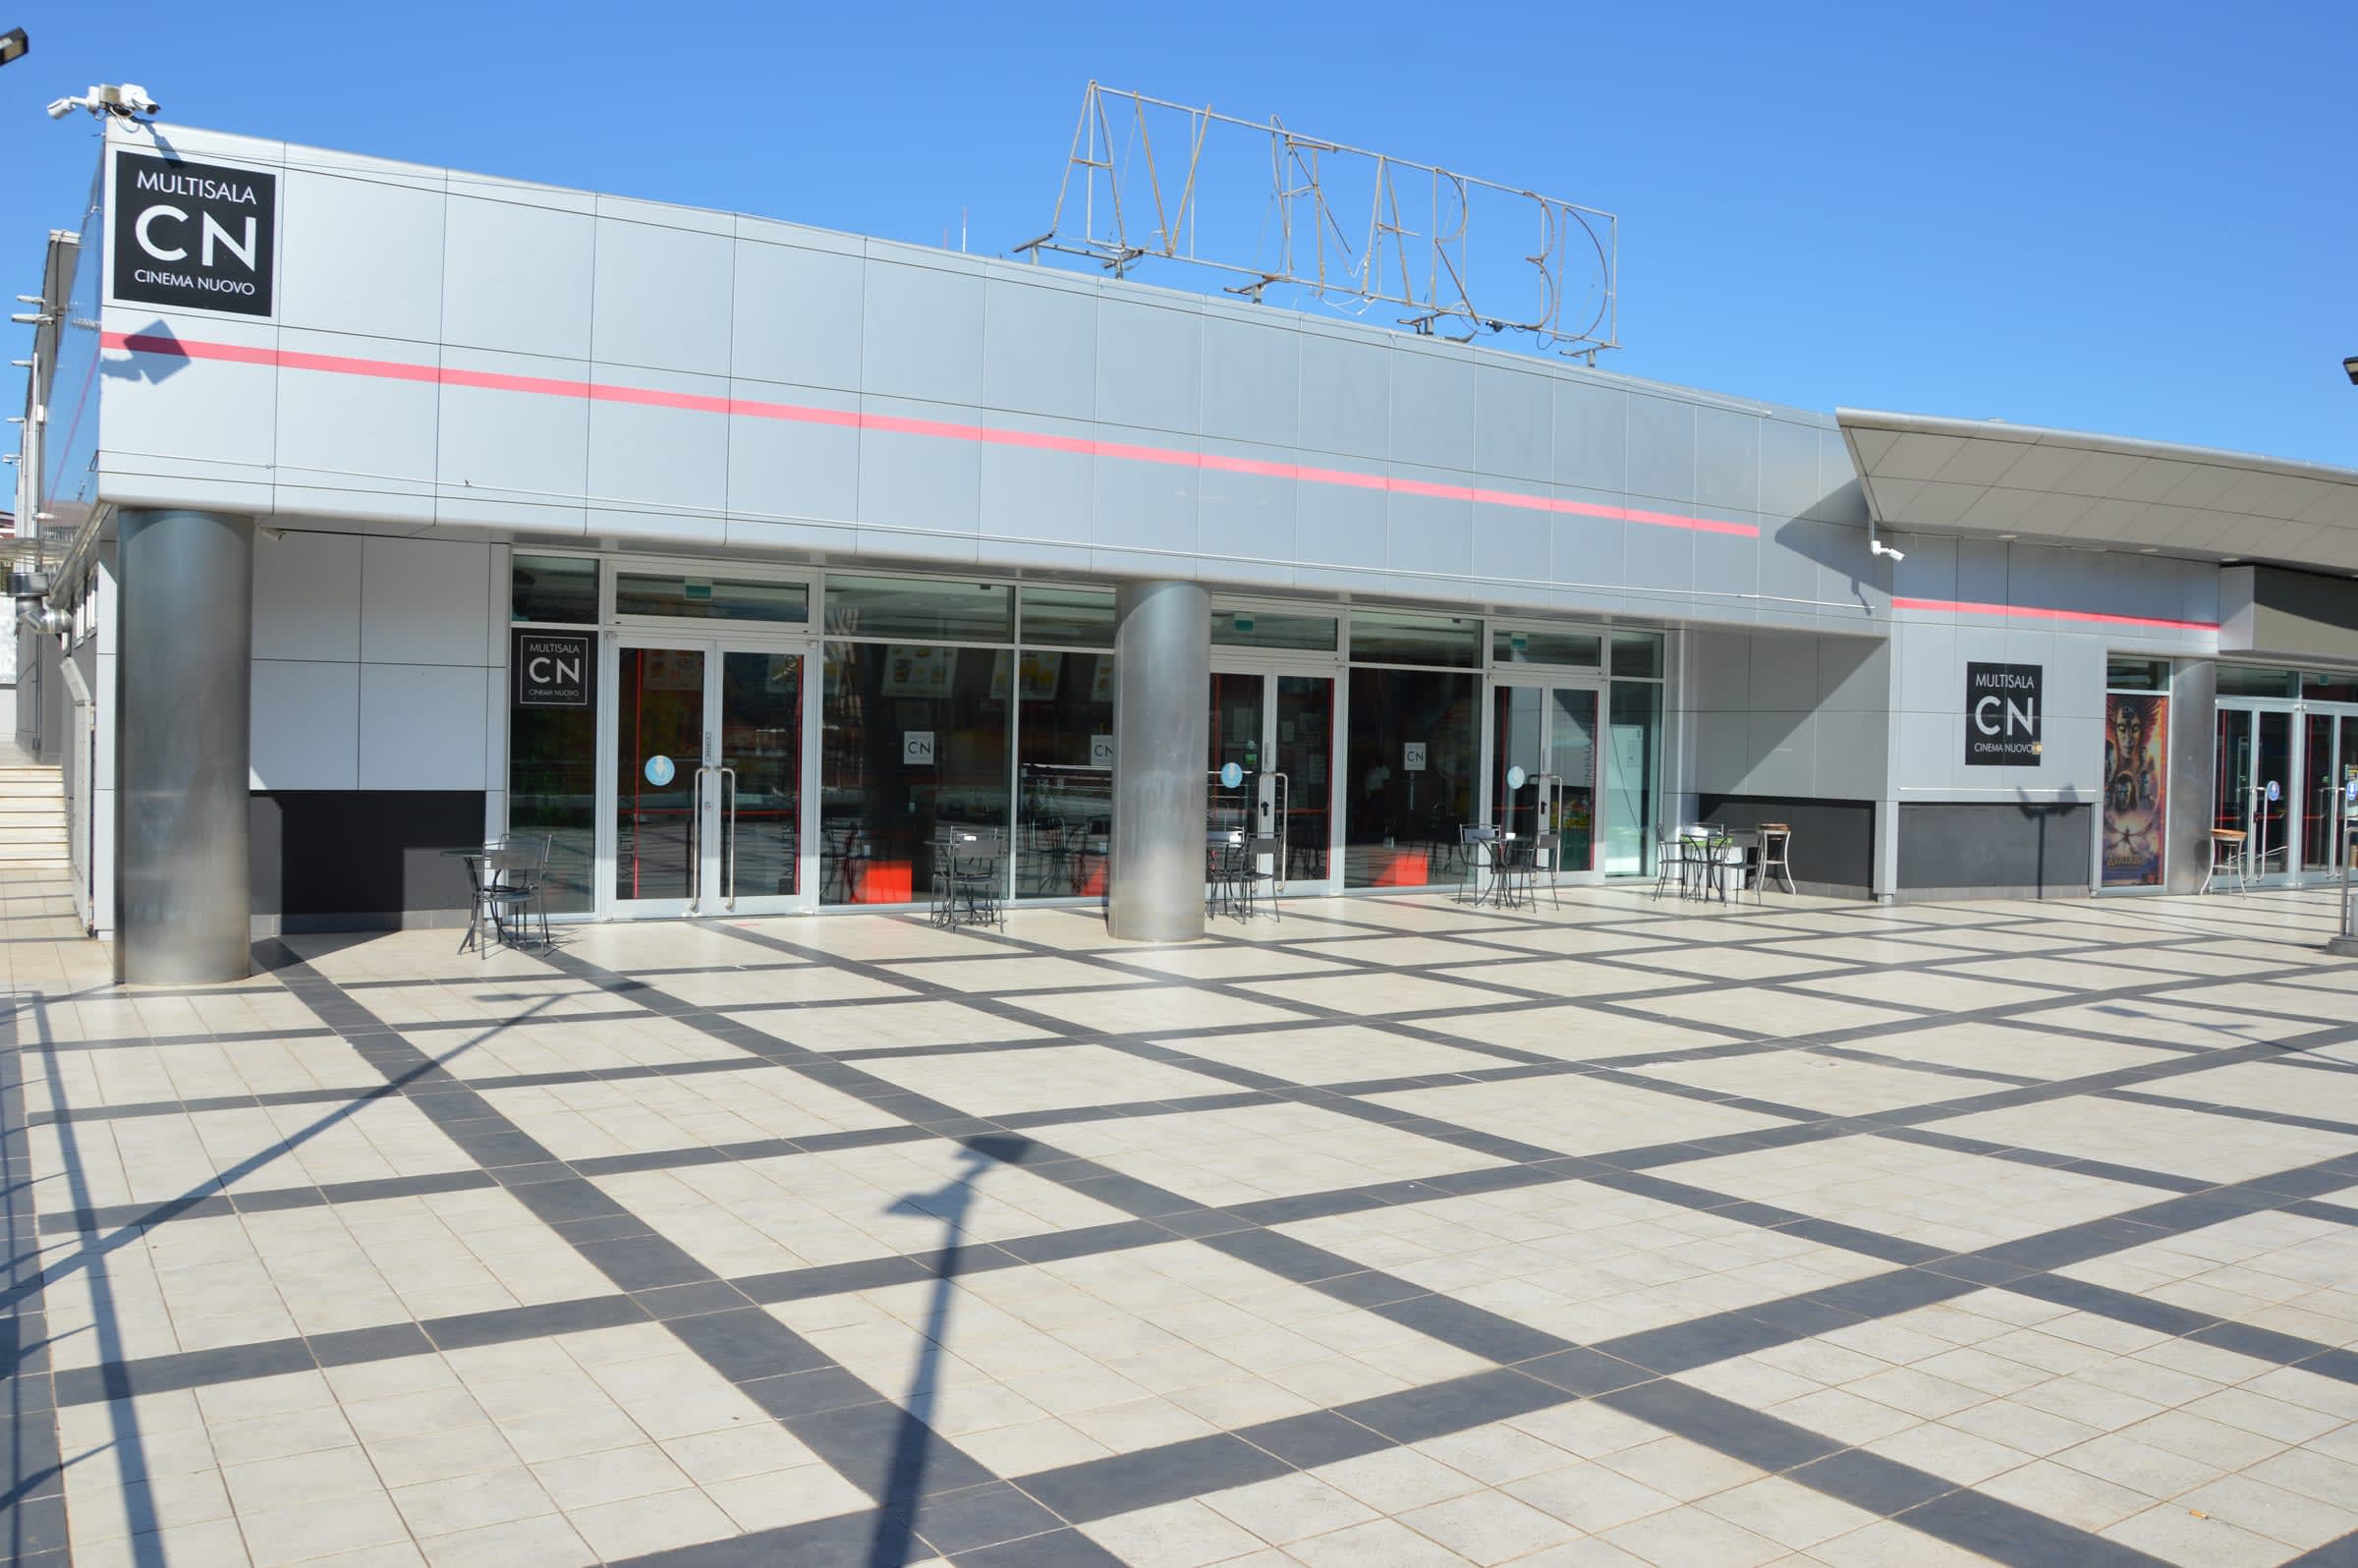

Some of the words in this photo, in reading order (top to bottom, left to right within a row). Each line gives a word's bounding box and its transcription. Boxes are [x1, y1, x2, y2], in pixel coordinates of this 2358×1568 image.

[137, 169, 257, 205] MULTISALA
[135, 204, 257, 272] CN
[134, 269, 194, 289] CINEMA
[197, 276, 255, 296] NUOVO
[530, 644, 581, 654] MULTISALA
[529, 656, 580, 684] CN
[1975, 673, 2036, 690] MULTISALA
[1974, 695, 2034, 736] CN
[907, 740, 931, 755] CN
[1407, 751, 1424, 762] CN
[1974, 742, 2003, 753] CINEMA
